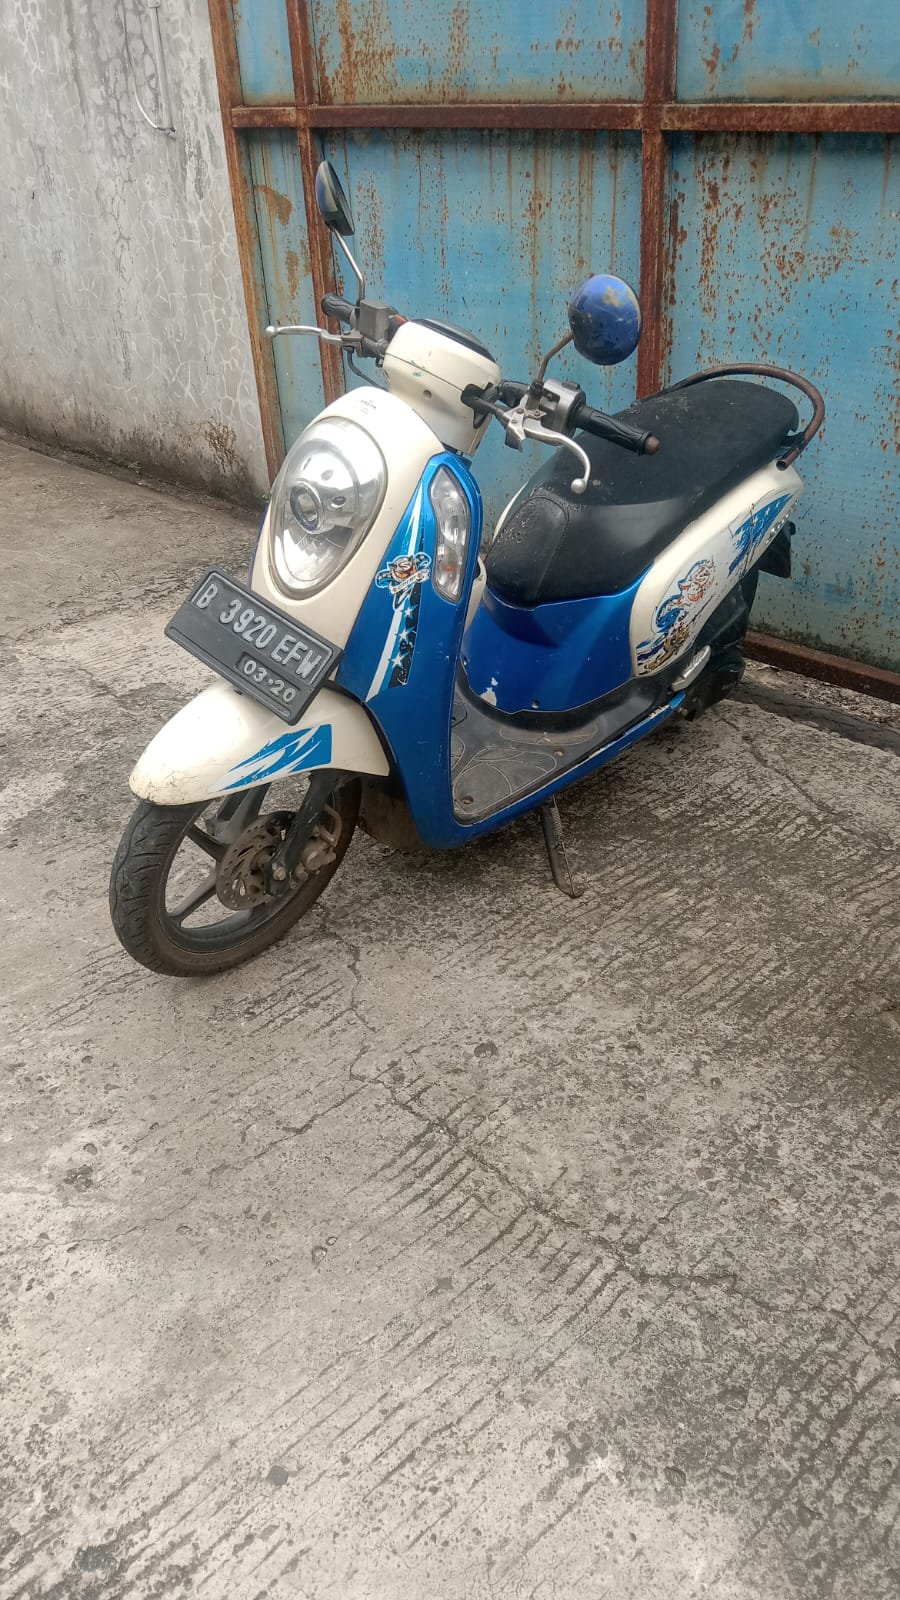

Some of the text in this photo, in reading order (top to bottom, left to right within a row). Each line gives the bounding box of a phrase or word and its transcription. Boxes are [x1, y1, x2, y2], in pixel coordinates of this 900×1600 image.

[196, 583, 322, 679] B 3920 EFW
